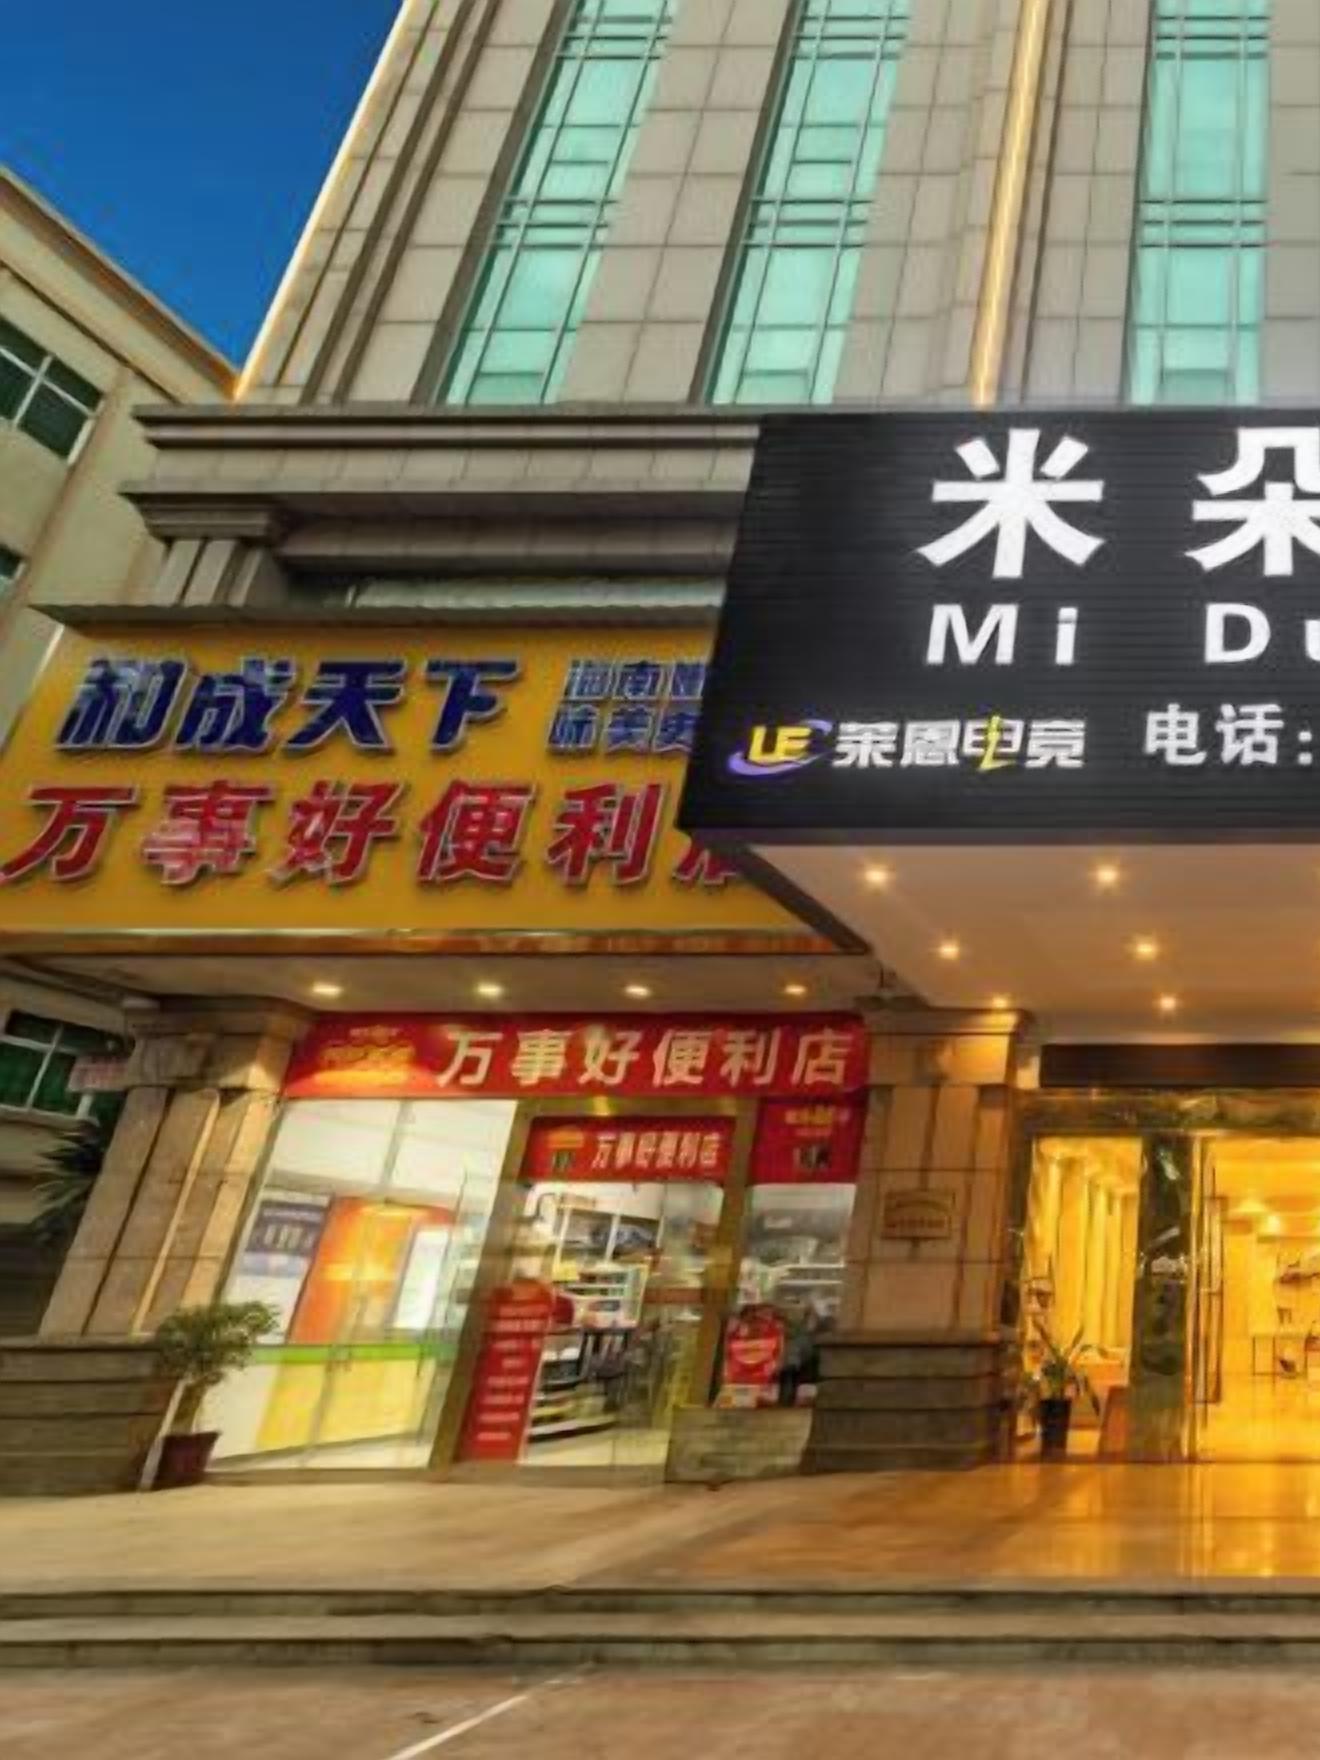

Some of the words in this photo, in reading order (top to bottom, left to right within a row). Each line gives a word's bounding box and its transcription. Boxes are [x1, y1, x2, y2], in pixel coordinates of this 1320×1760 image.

[926, 604, 1078, 665] Mi
[54, 656, 522, 753] 和成天下
[831, 715, 1086, 771] 莱恩电竞
[436, 1025, 856, 1089] 万事好便利店
